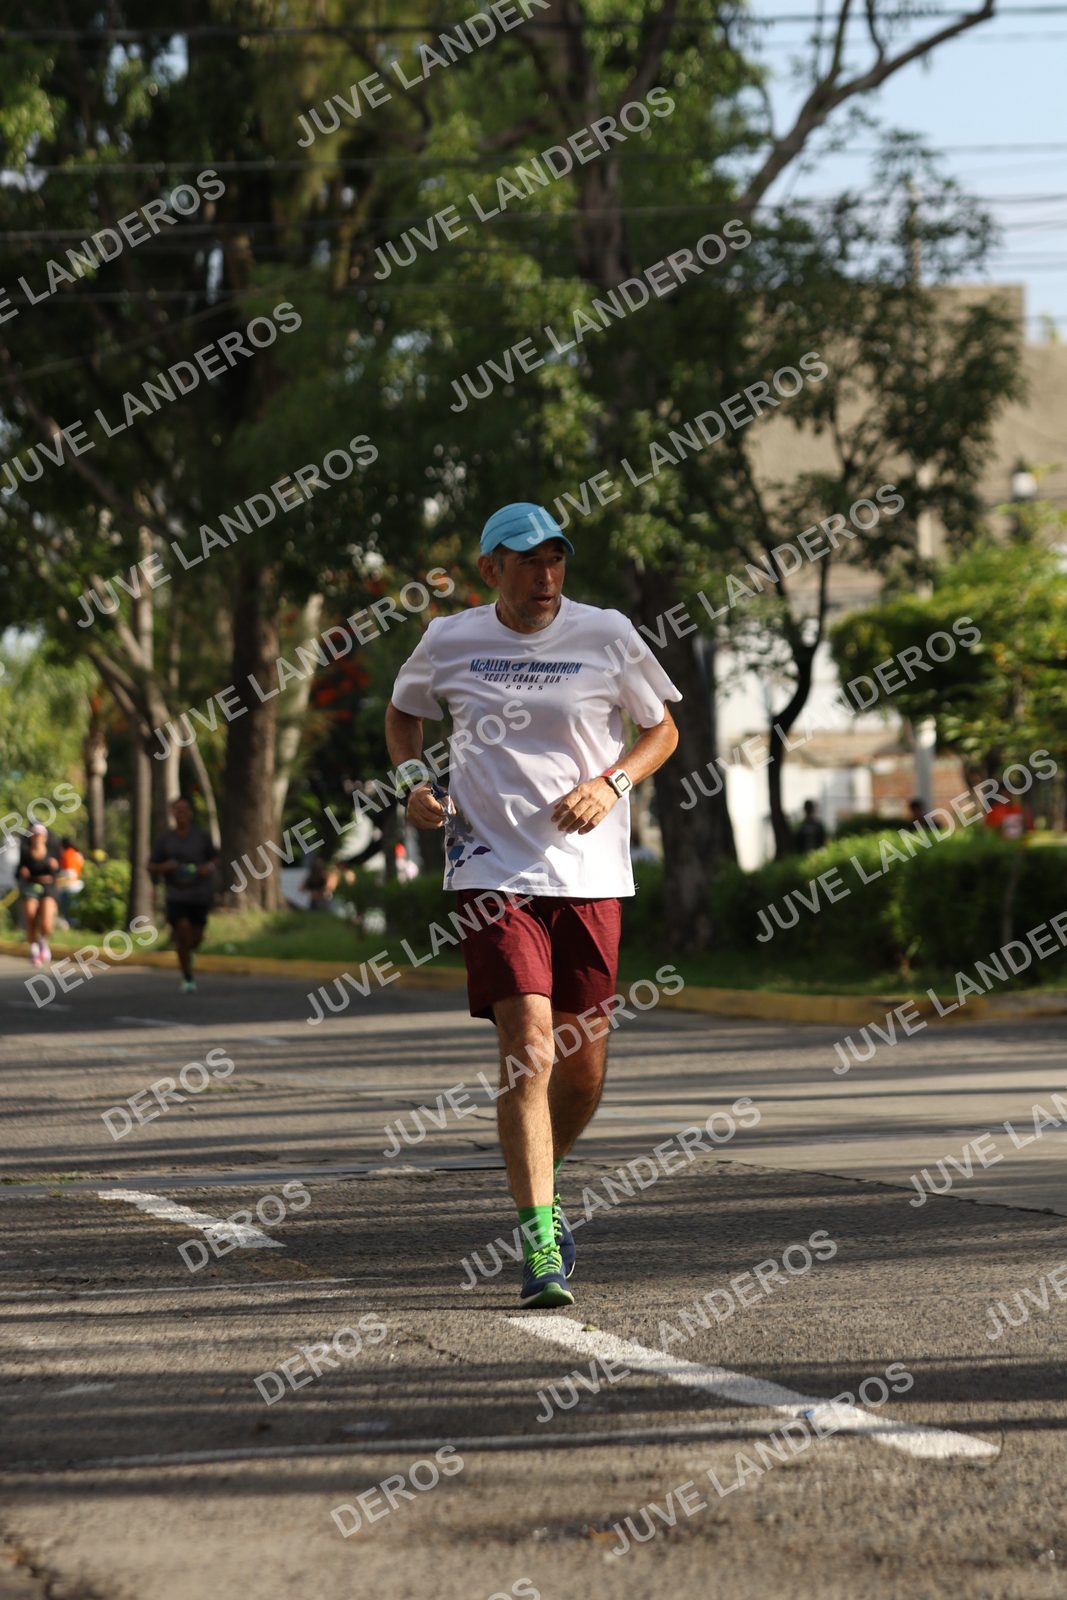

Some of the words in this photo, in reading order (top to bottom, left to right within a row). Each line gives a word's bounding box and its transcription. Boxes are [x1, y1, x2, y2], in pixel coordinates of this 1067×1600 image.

[470, 659, 511, 672] McALLEN
[528, 662, 582, 674] MARATHON
[483, 673, 509, 682] SCOTT
[513, 674, 540, 683] CRANE
[544, 675, 561, 683] RUN
